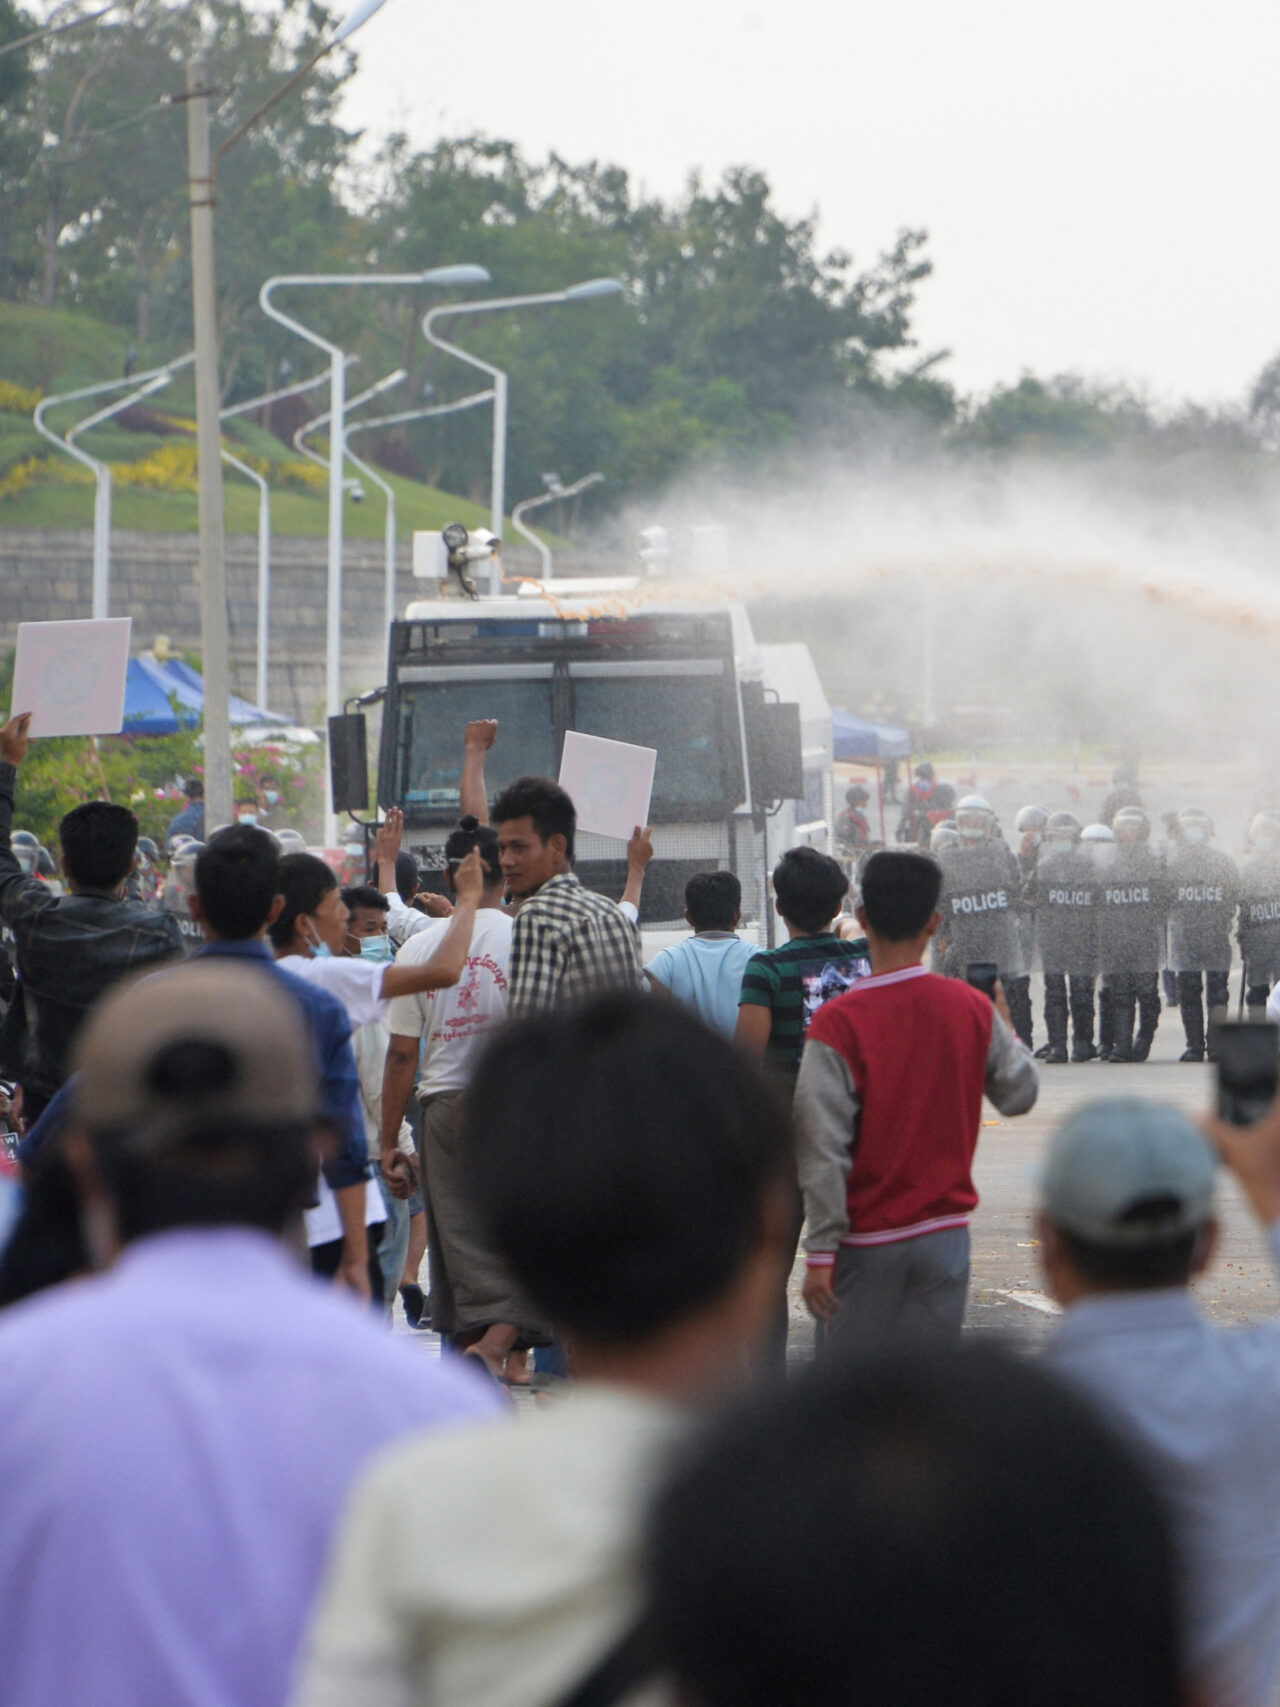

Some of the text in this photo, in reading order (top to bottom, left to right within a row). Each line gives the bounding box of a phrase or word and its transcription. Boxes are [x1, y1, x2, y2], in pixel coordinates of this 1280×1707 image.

[951, 890, 1008, 914] POLICE
[1049, 889, 1091, 906] POLICE
[1105, 887, 1150, 904] POLICE
[1178, 886, 1223, 902] POLICE
